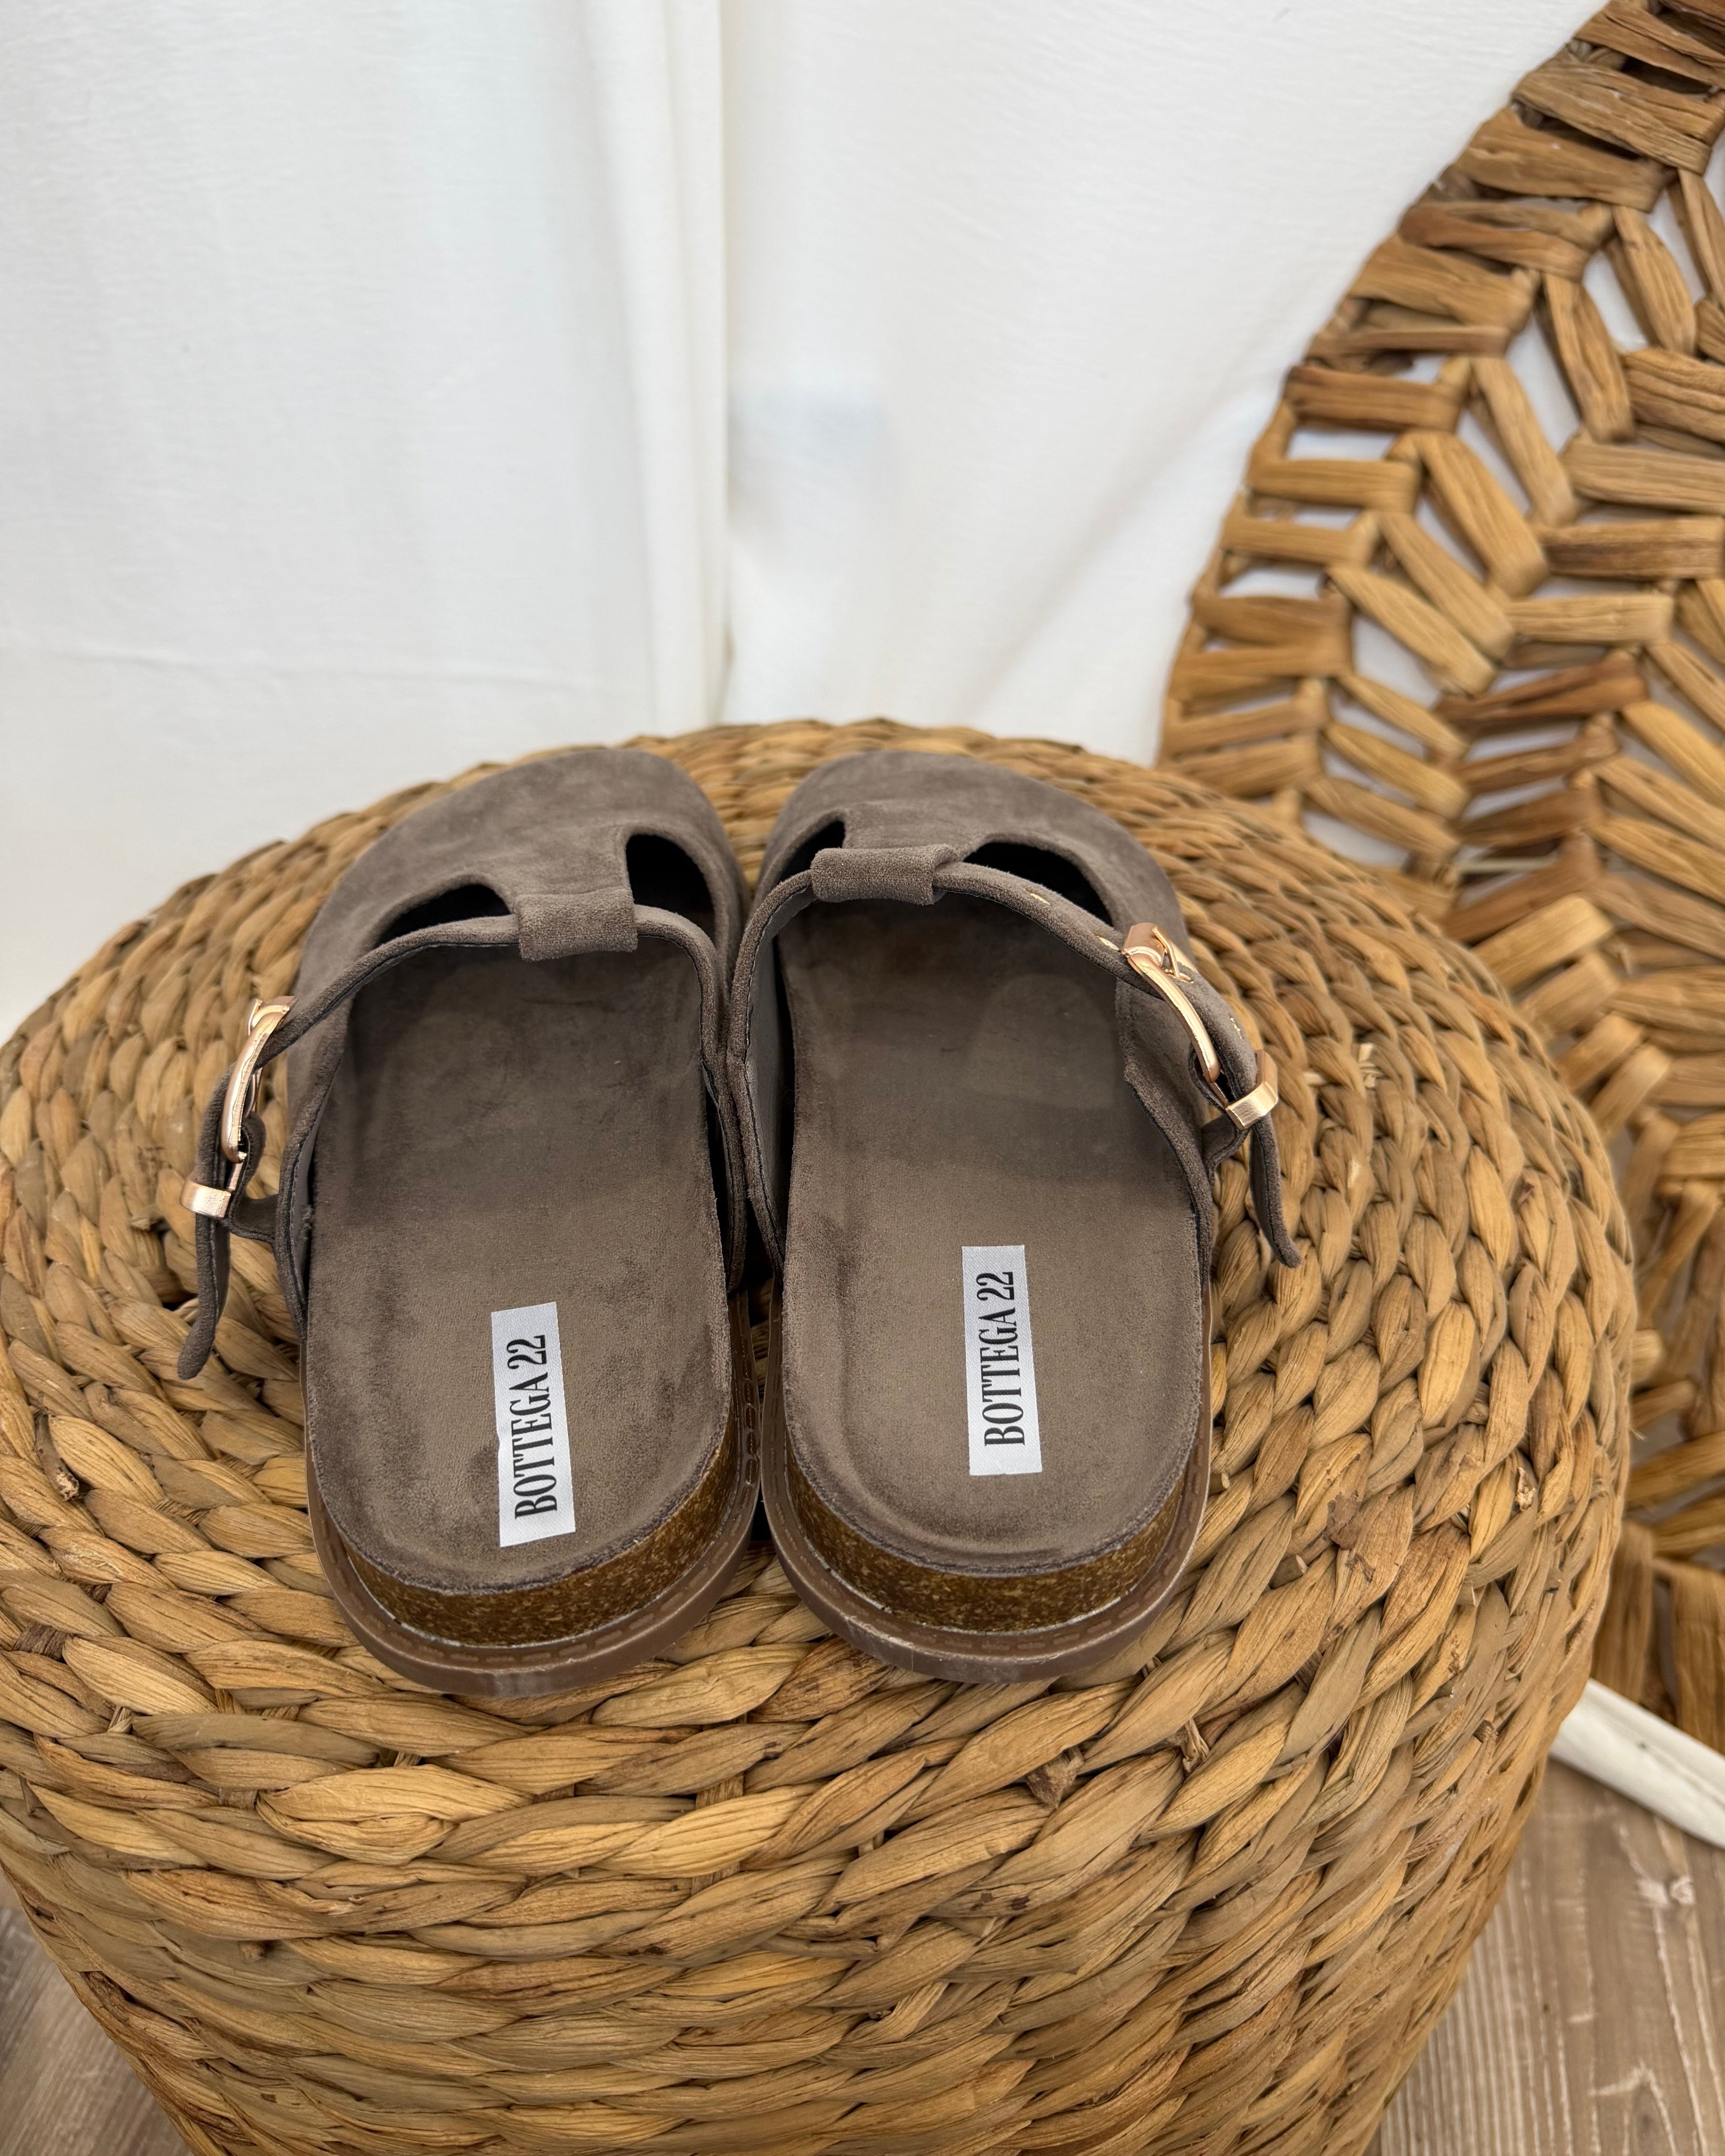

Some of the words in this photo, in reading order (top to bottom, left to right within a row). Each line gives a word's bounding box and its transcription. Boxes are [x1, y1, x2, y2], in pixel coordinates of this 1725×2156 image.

[976, 1271, 1015, 1301] 22
[506, 1334, 547, 1370] 22
[978, 1307, 1025, 1445] BOTTEGA
[509, 1372, 557, 1519] BOTTEGA
